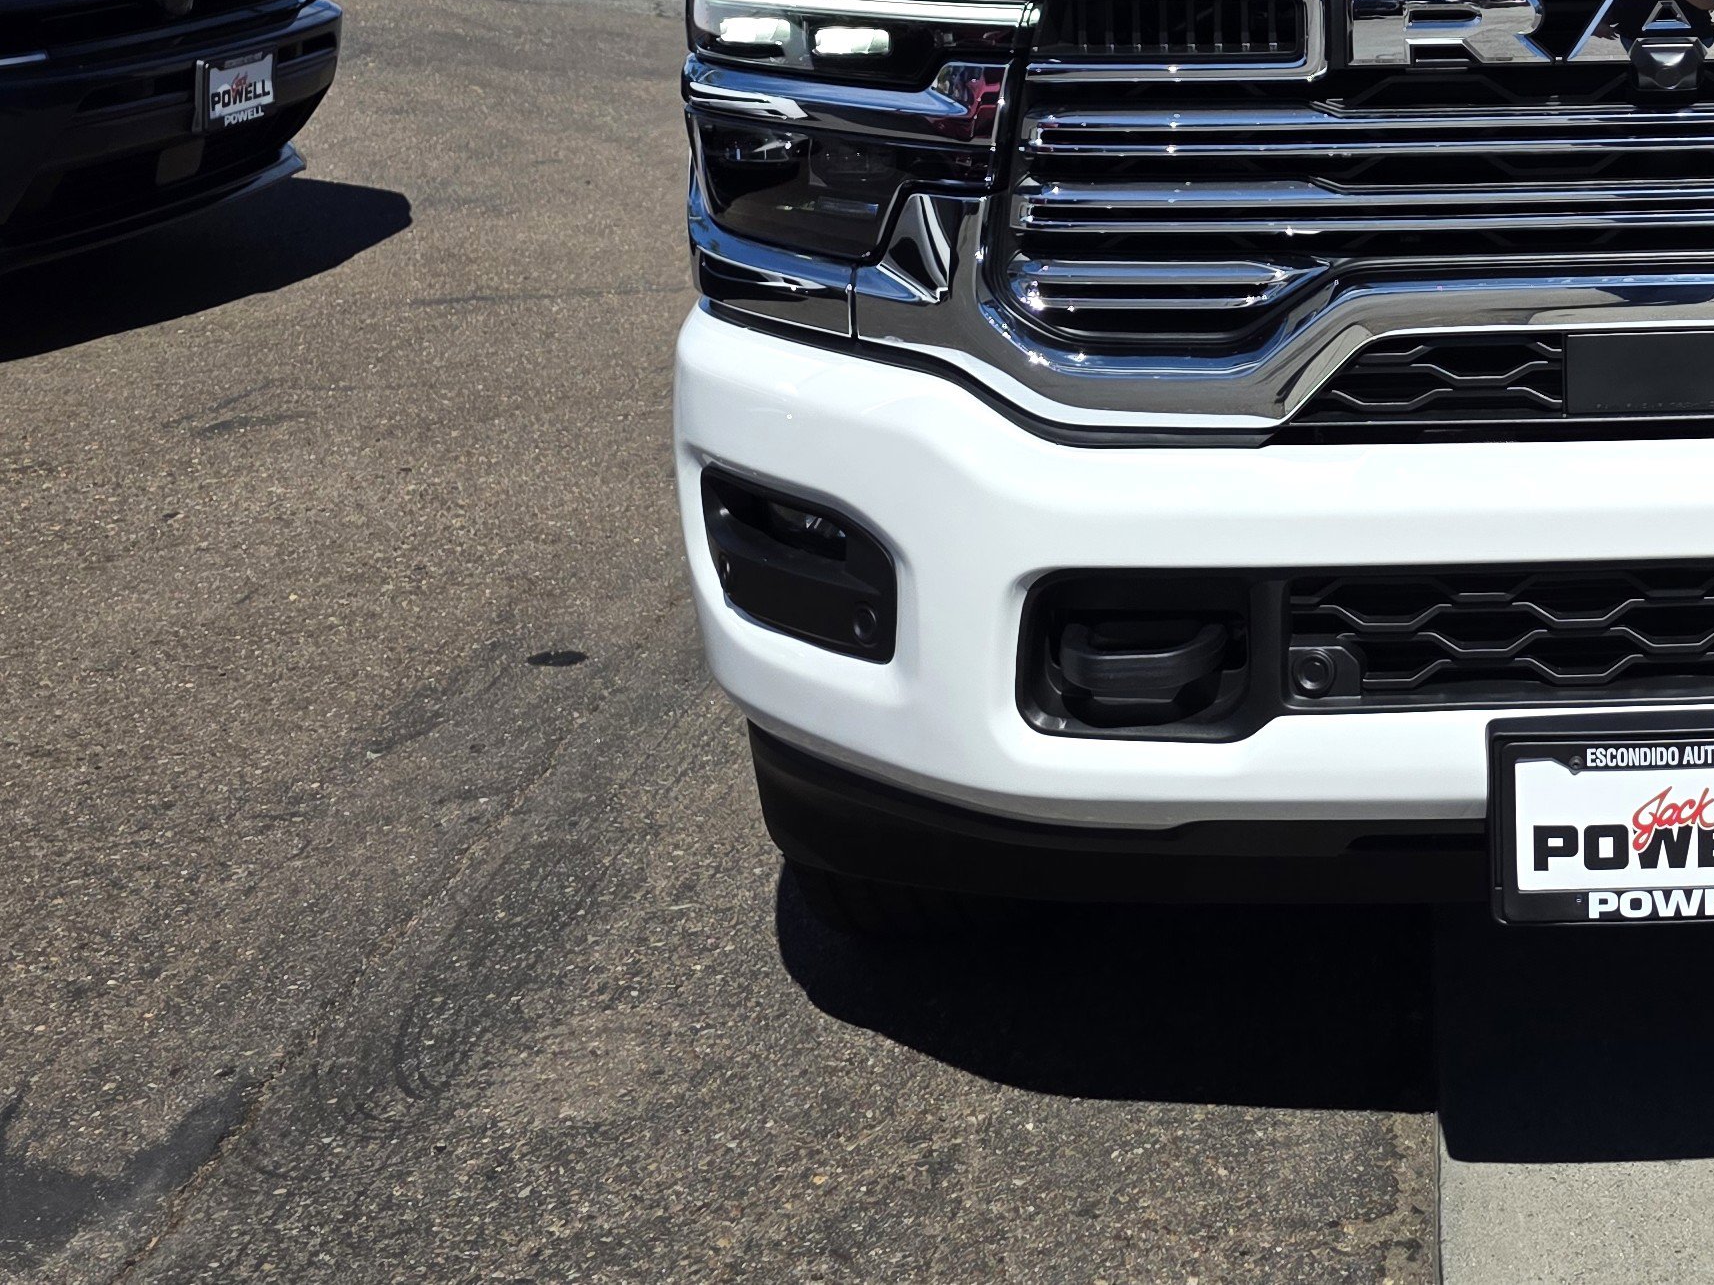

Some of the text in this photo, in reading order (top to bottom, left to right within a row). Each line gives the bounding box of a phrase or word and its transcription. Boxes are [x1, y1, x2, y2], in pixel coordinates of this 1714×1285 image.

[210, 78, 271, 112] POWELL
[224, 105, 264, 127] POWELL
[1586, 746, 1680, 768] ESCONDIDO
